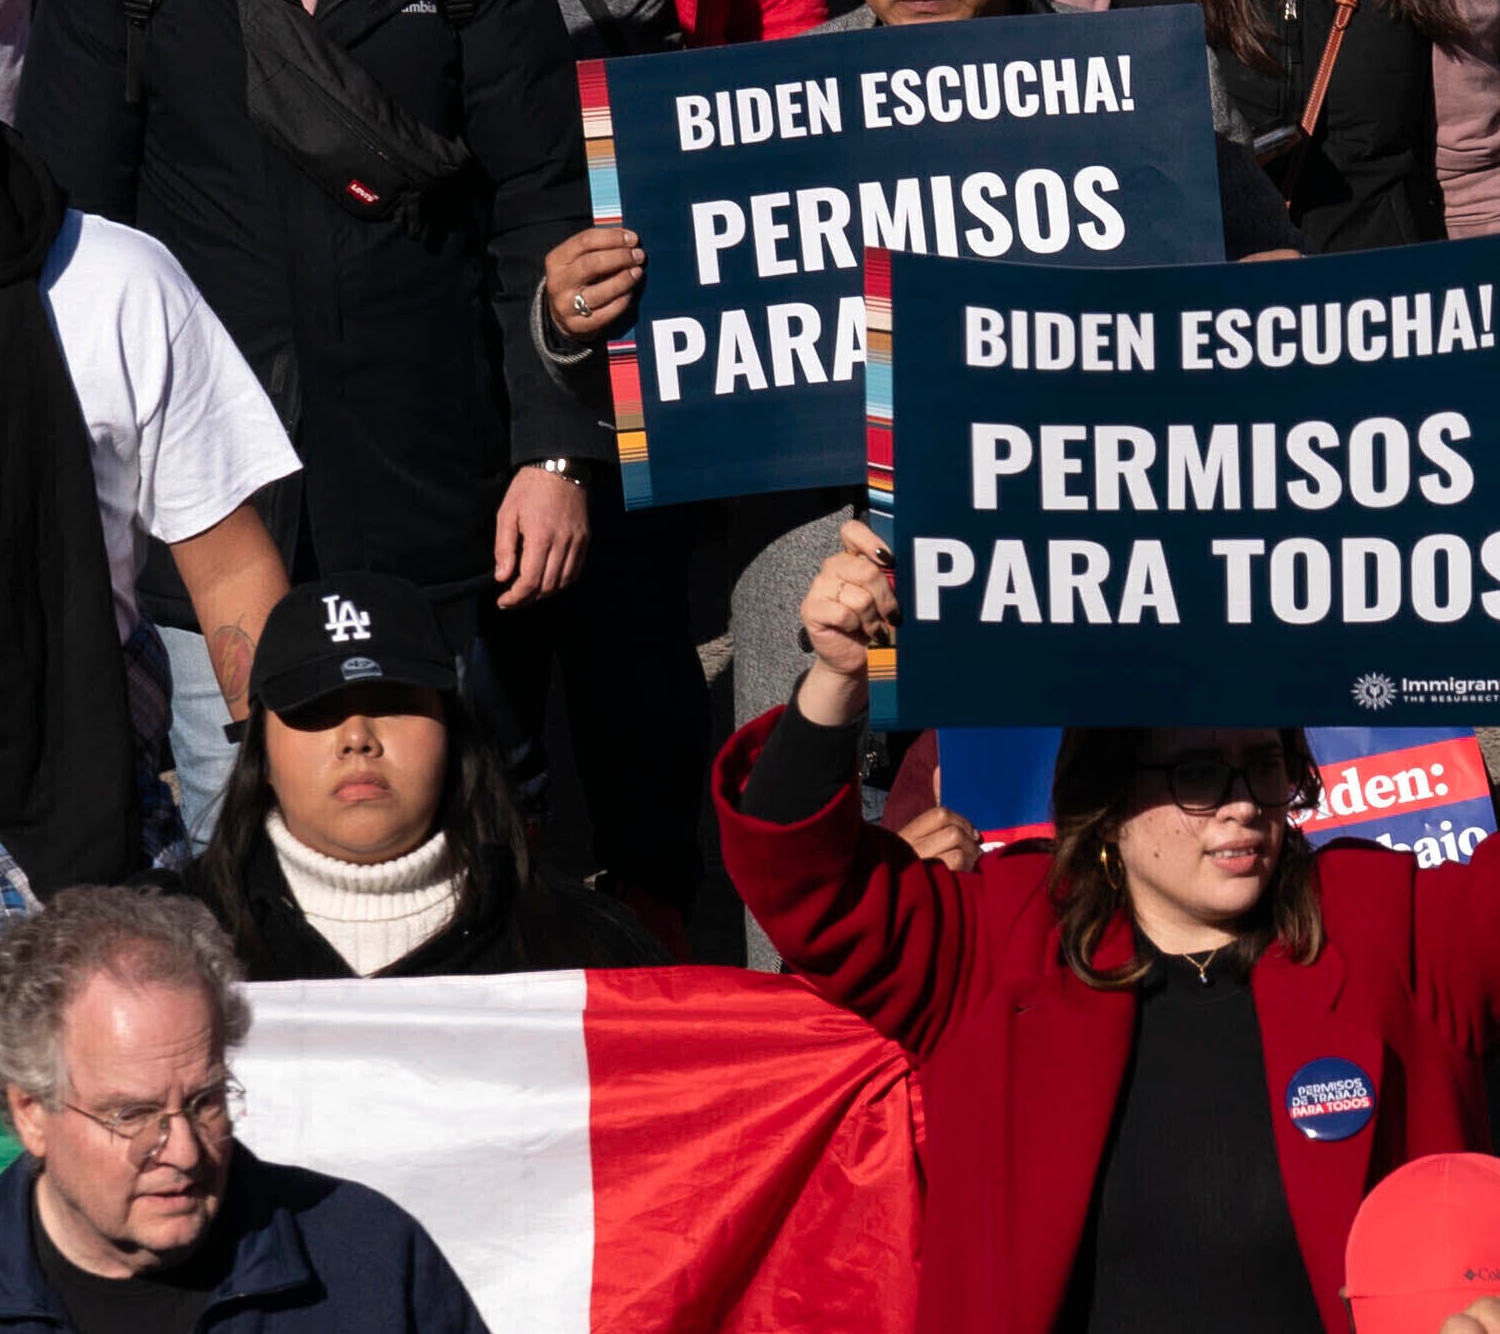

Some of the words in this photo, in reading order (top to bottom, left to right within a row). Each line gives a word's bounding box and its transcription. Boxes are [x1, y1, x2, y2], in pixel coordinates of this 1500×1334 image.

[676, 78, 843, 152] BIDEN
[861, 54, 1136, 123] ESCUCHA!
[691, 165, 1128, 286] PERMISOS
[964, 305, 1157, 371] BIDEN
[1180, 284, 1498, 371] ESCUCHA!
[970, 411, 1475, 511] PERMISOS
[913, 533, 1181, 625] PARA
[322, 594, 371, 642] LA
[1403, 694, 1425, 703] THE
[1291, 1104, 1325, 1119] PARA
[1325, 1096, 1371, 1113] TODOS
[1292, 1096, 1308, 1107] DE
[1312, 1087, 1367, 1104] TRABAJO
[1297, 1078, 1363, 1097] PERMISOS
